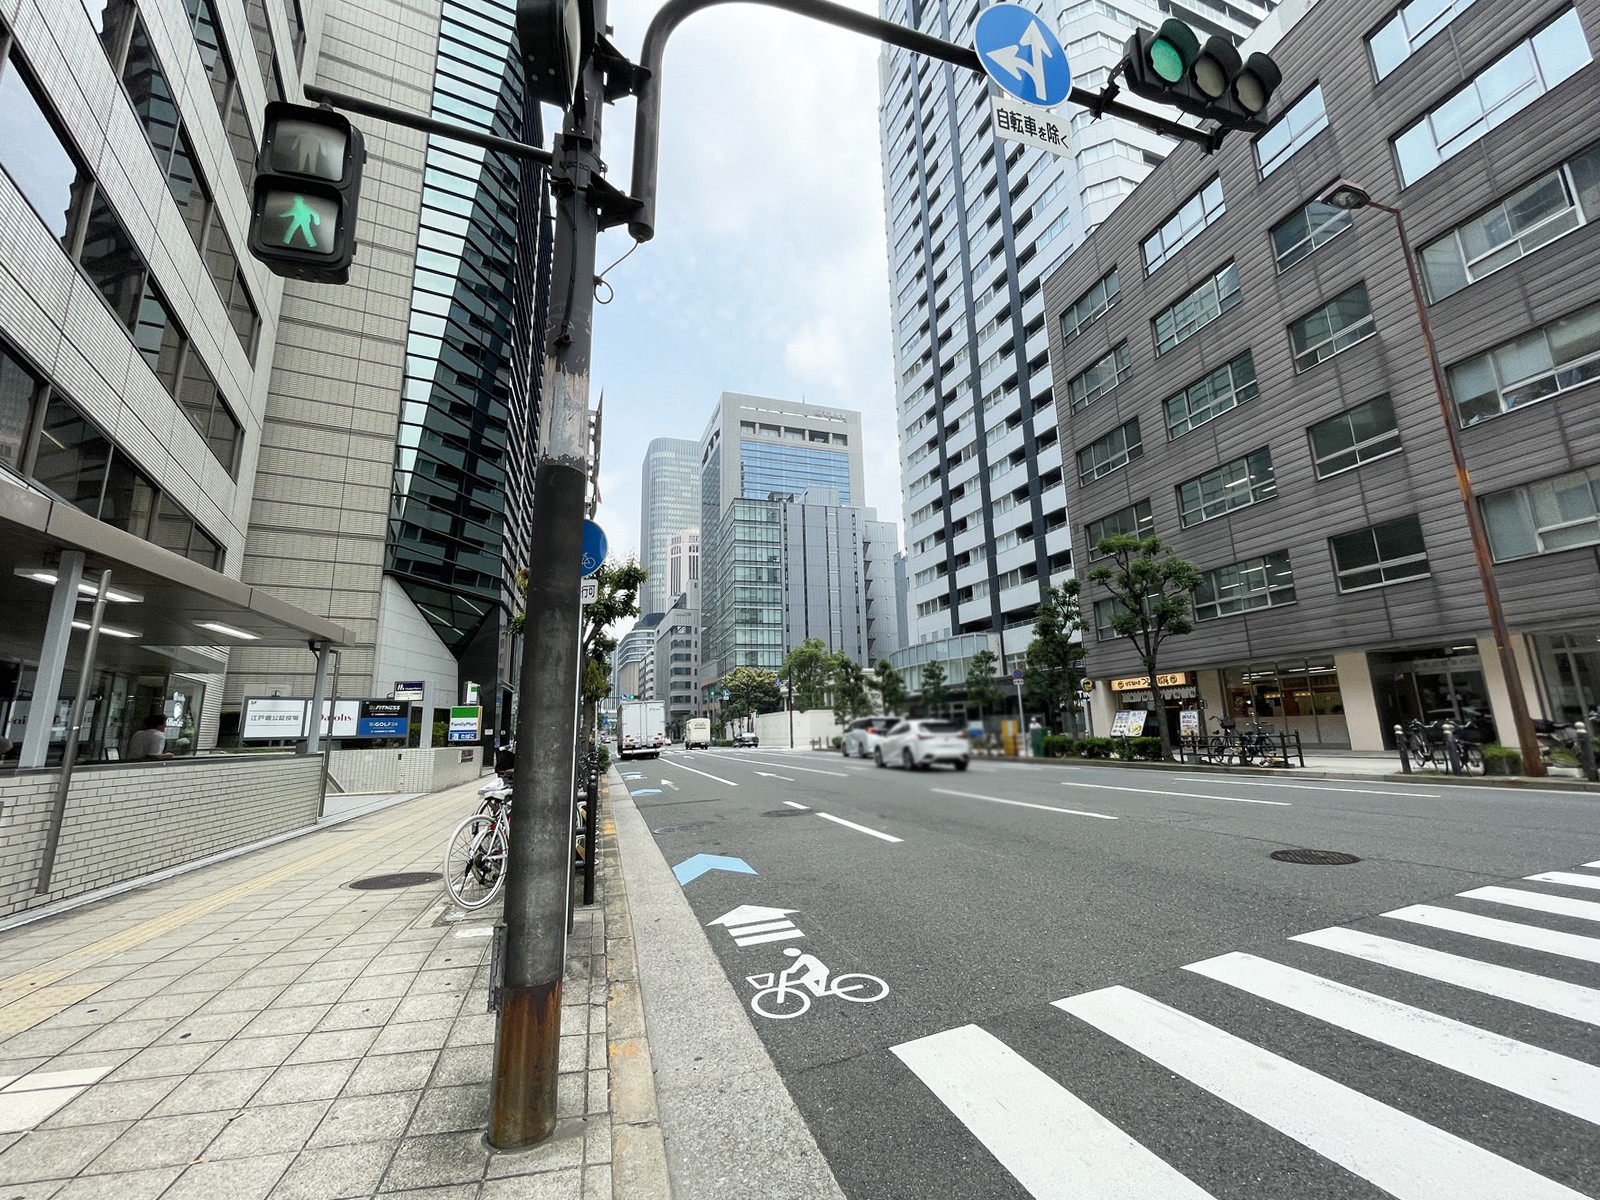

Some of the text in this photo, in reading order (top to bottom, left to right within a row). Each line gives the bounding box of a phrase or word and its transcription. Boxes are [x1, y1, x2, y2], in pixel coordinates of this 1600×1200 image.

[996, 108, 1069, 149] 自転車を除く
